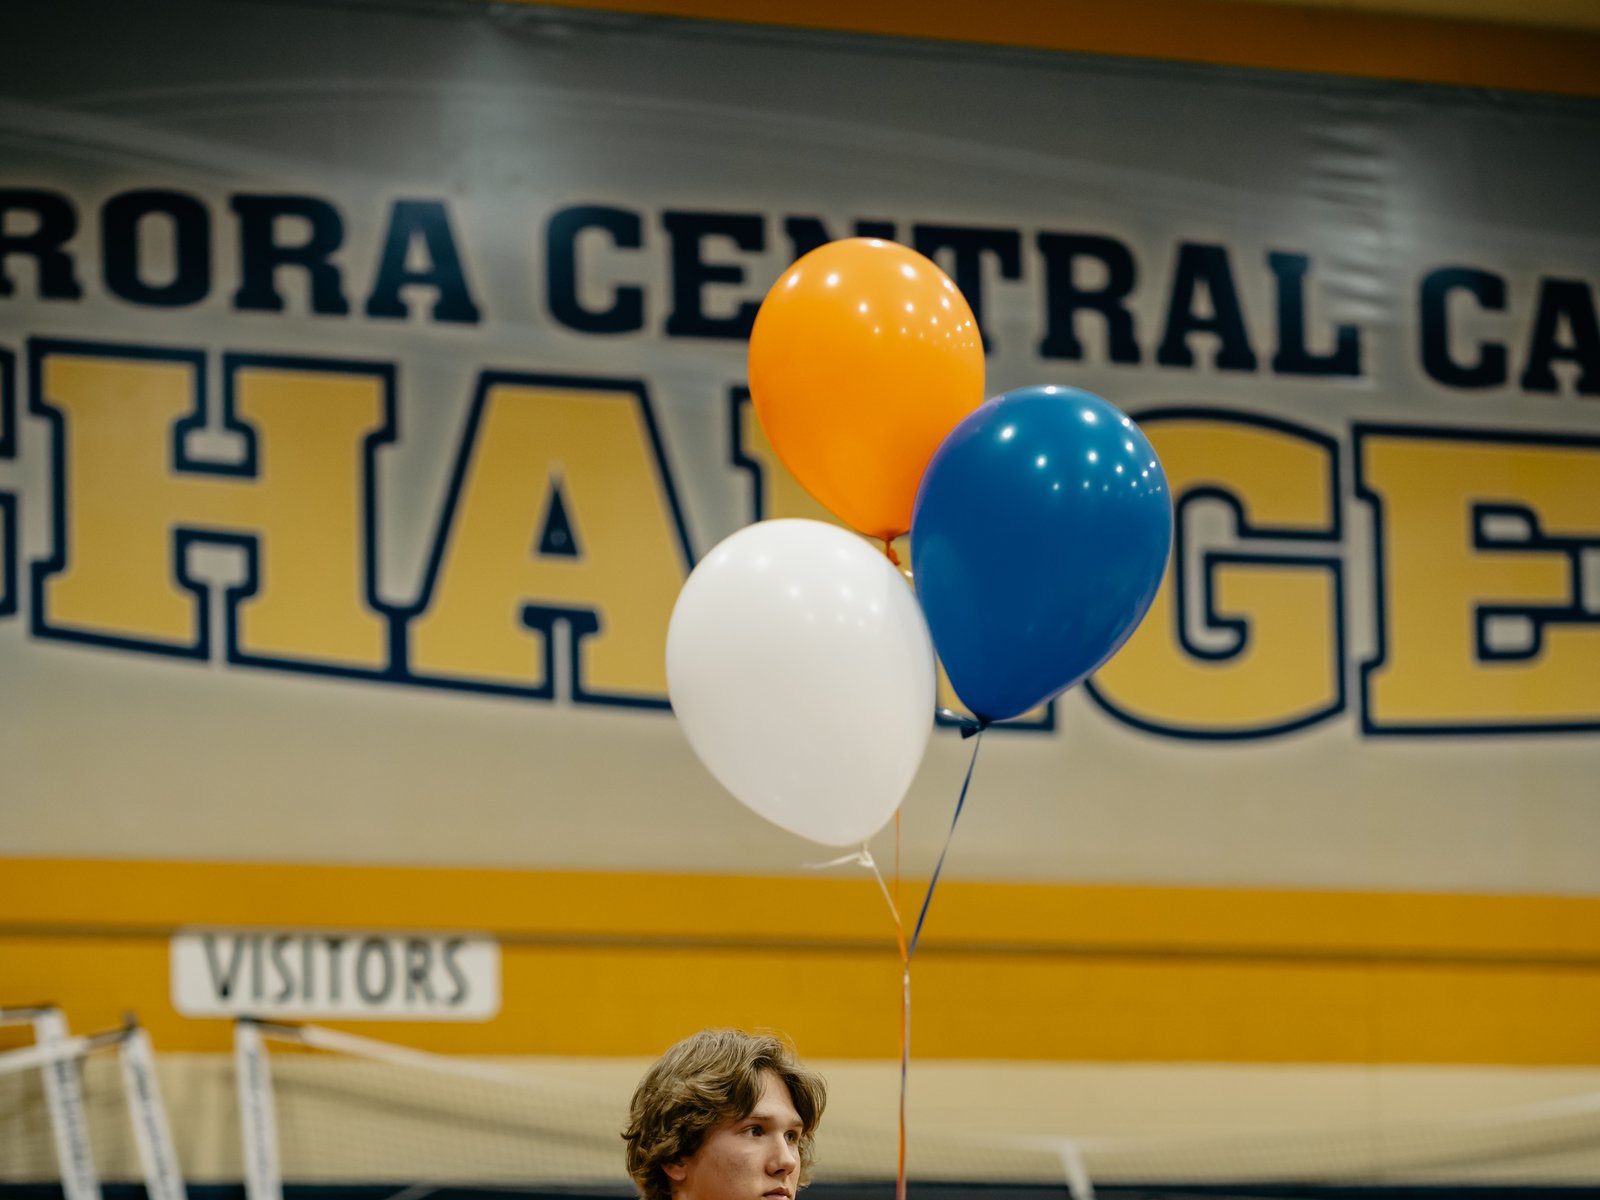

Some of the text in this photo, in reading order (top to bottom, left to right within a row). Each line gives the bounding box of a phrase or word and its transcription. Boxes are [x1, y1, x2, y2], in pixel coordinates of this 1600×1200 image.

[543, 204, 1362, 378] CETRAL
[0, 334, 1600, 745] HAGE
[202, 934, 470, 1006] VISITORS
